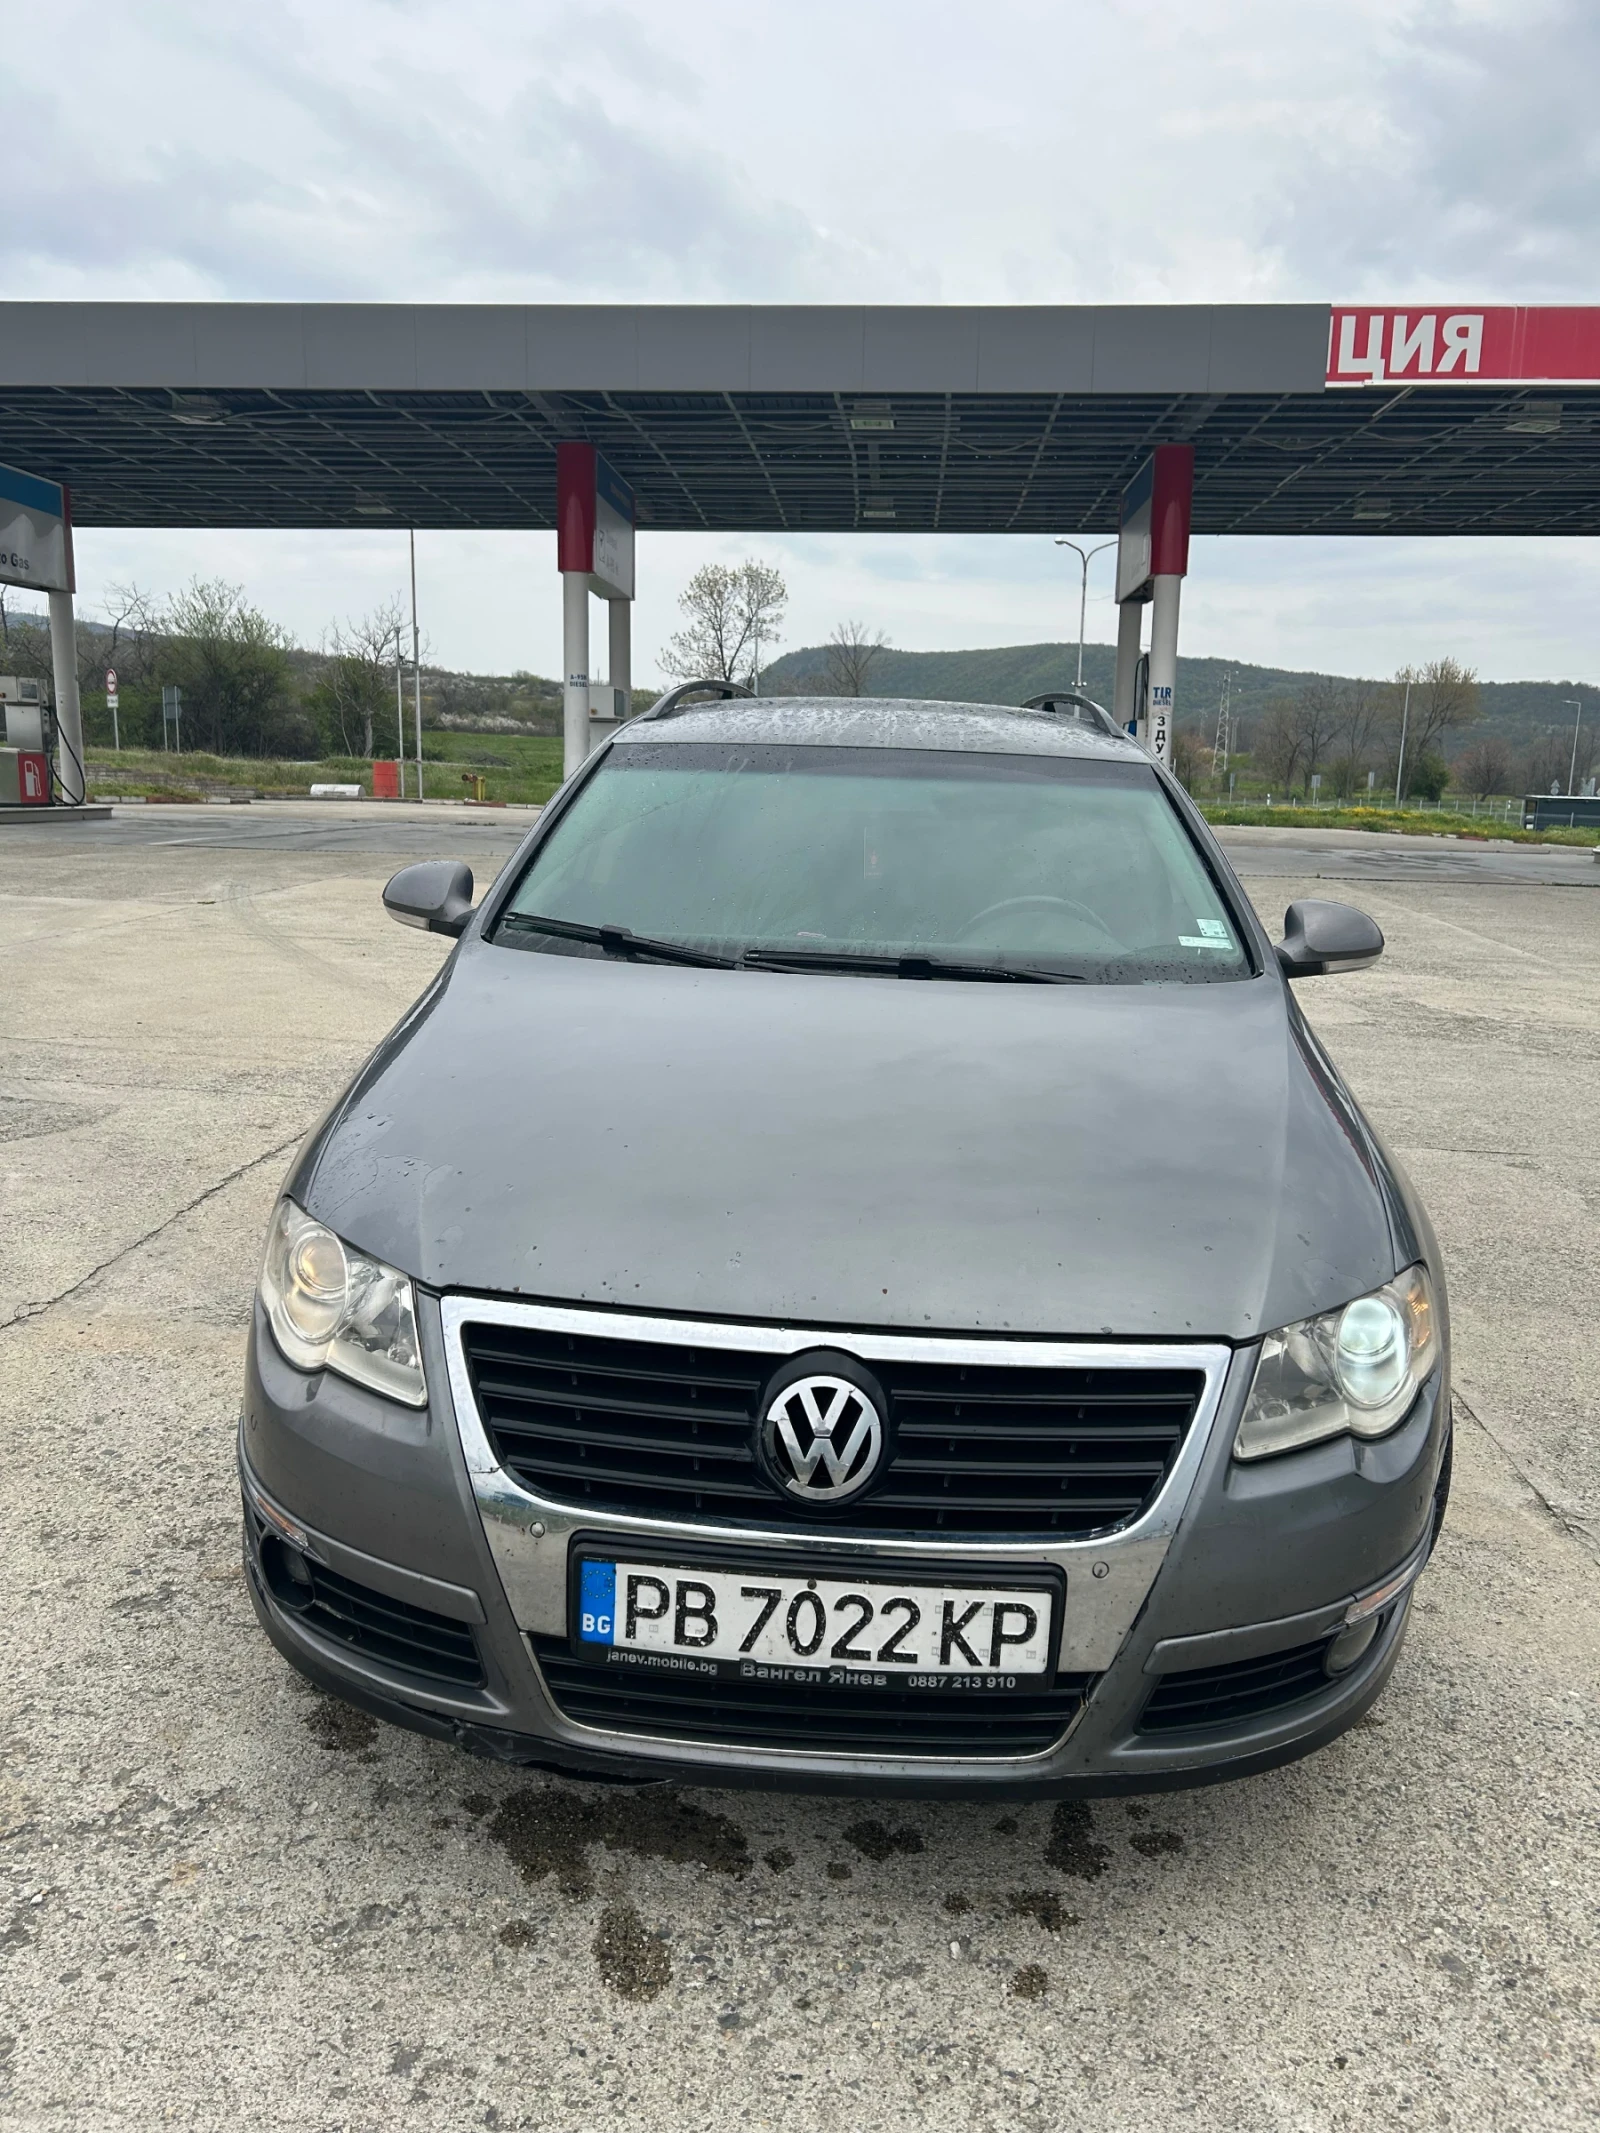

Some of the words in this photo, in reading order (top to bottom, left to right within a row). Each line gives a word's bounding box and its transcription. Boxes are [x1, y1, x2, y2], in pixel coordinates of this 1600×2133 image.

[1326, 314, 1484, 380] ЦИЯ
[10, 552, 30, 570] Gas
[1153, 686, 1172, 699] TIR
[582, 1613, 611, 1634] BG
[625, 1574, 719, 1648] PB
[738, 1587, 921, 1664] 7022
[938, 1599, 1038, 1667] KP
[606, 1650, 718, 1675] janev.mobile.bg
[741, 1661, 821, 1684] Вангел
[828, 1667, 887, 1686] Янев
[907, 1675, 948, 1688] 0887
[952, 1676, 982, 1688] 213
[986, 1676, 1017, 1689] 910
